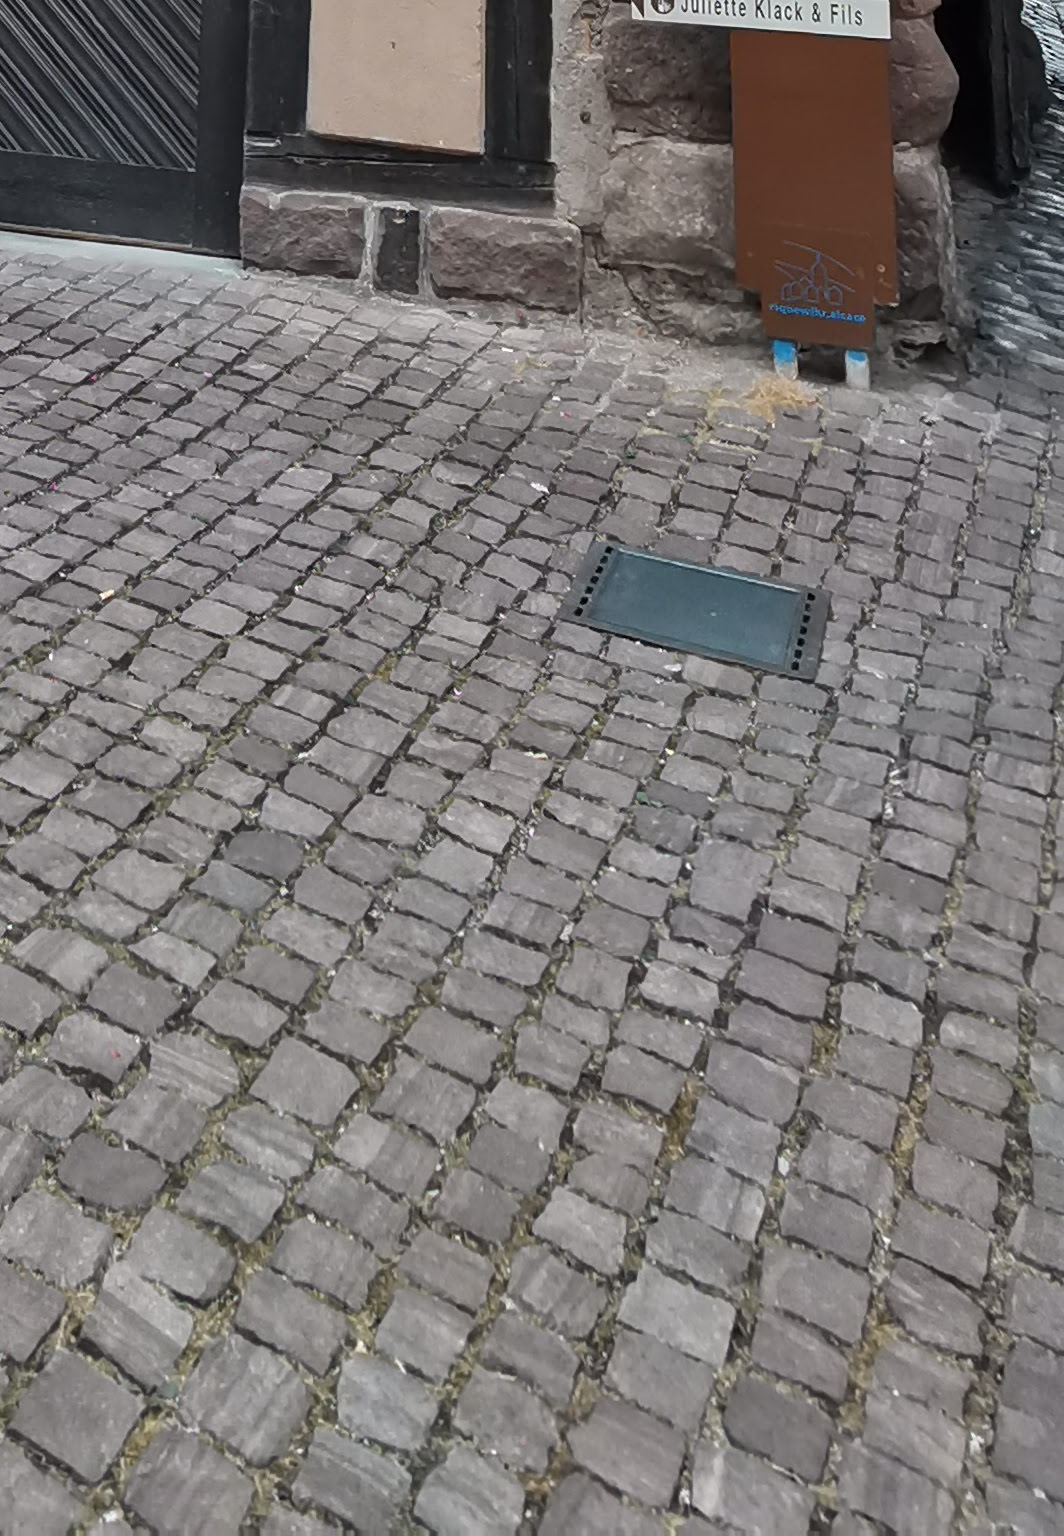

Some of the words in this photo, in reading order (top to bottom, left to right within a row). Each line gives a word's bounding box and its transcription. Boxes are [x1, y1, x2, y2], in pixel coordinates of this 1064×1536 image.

[754, 0, 804, 21] Klack
[811, 3, 822, 23] &
[830, 4, 863, 26] Fils
